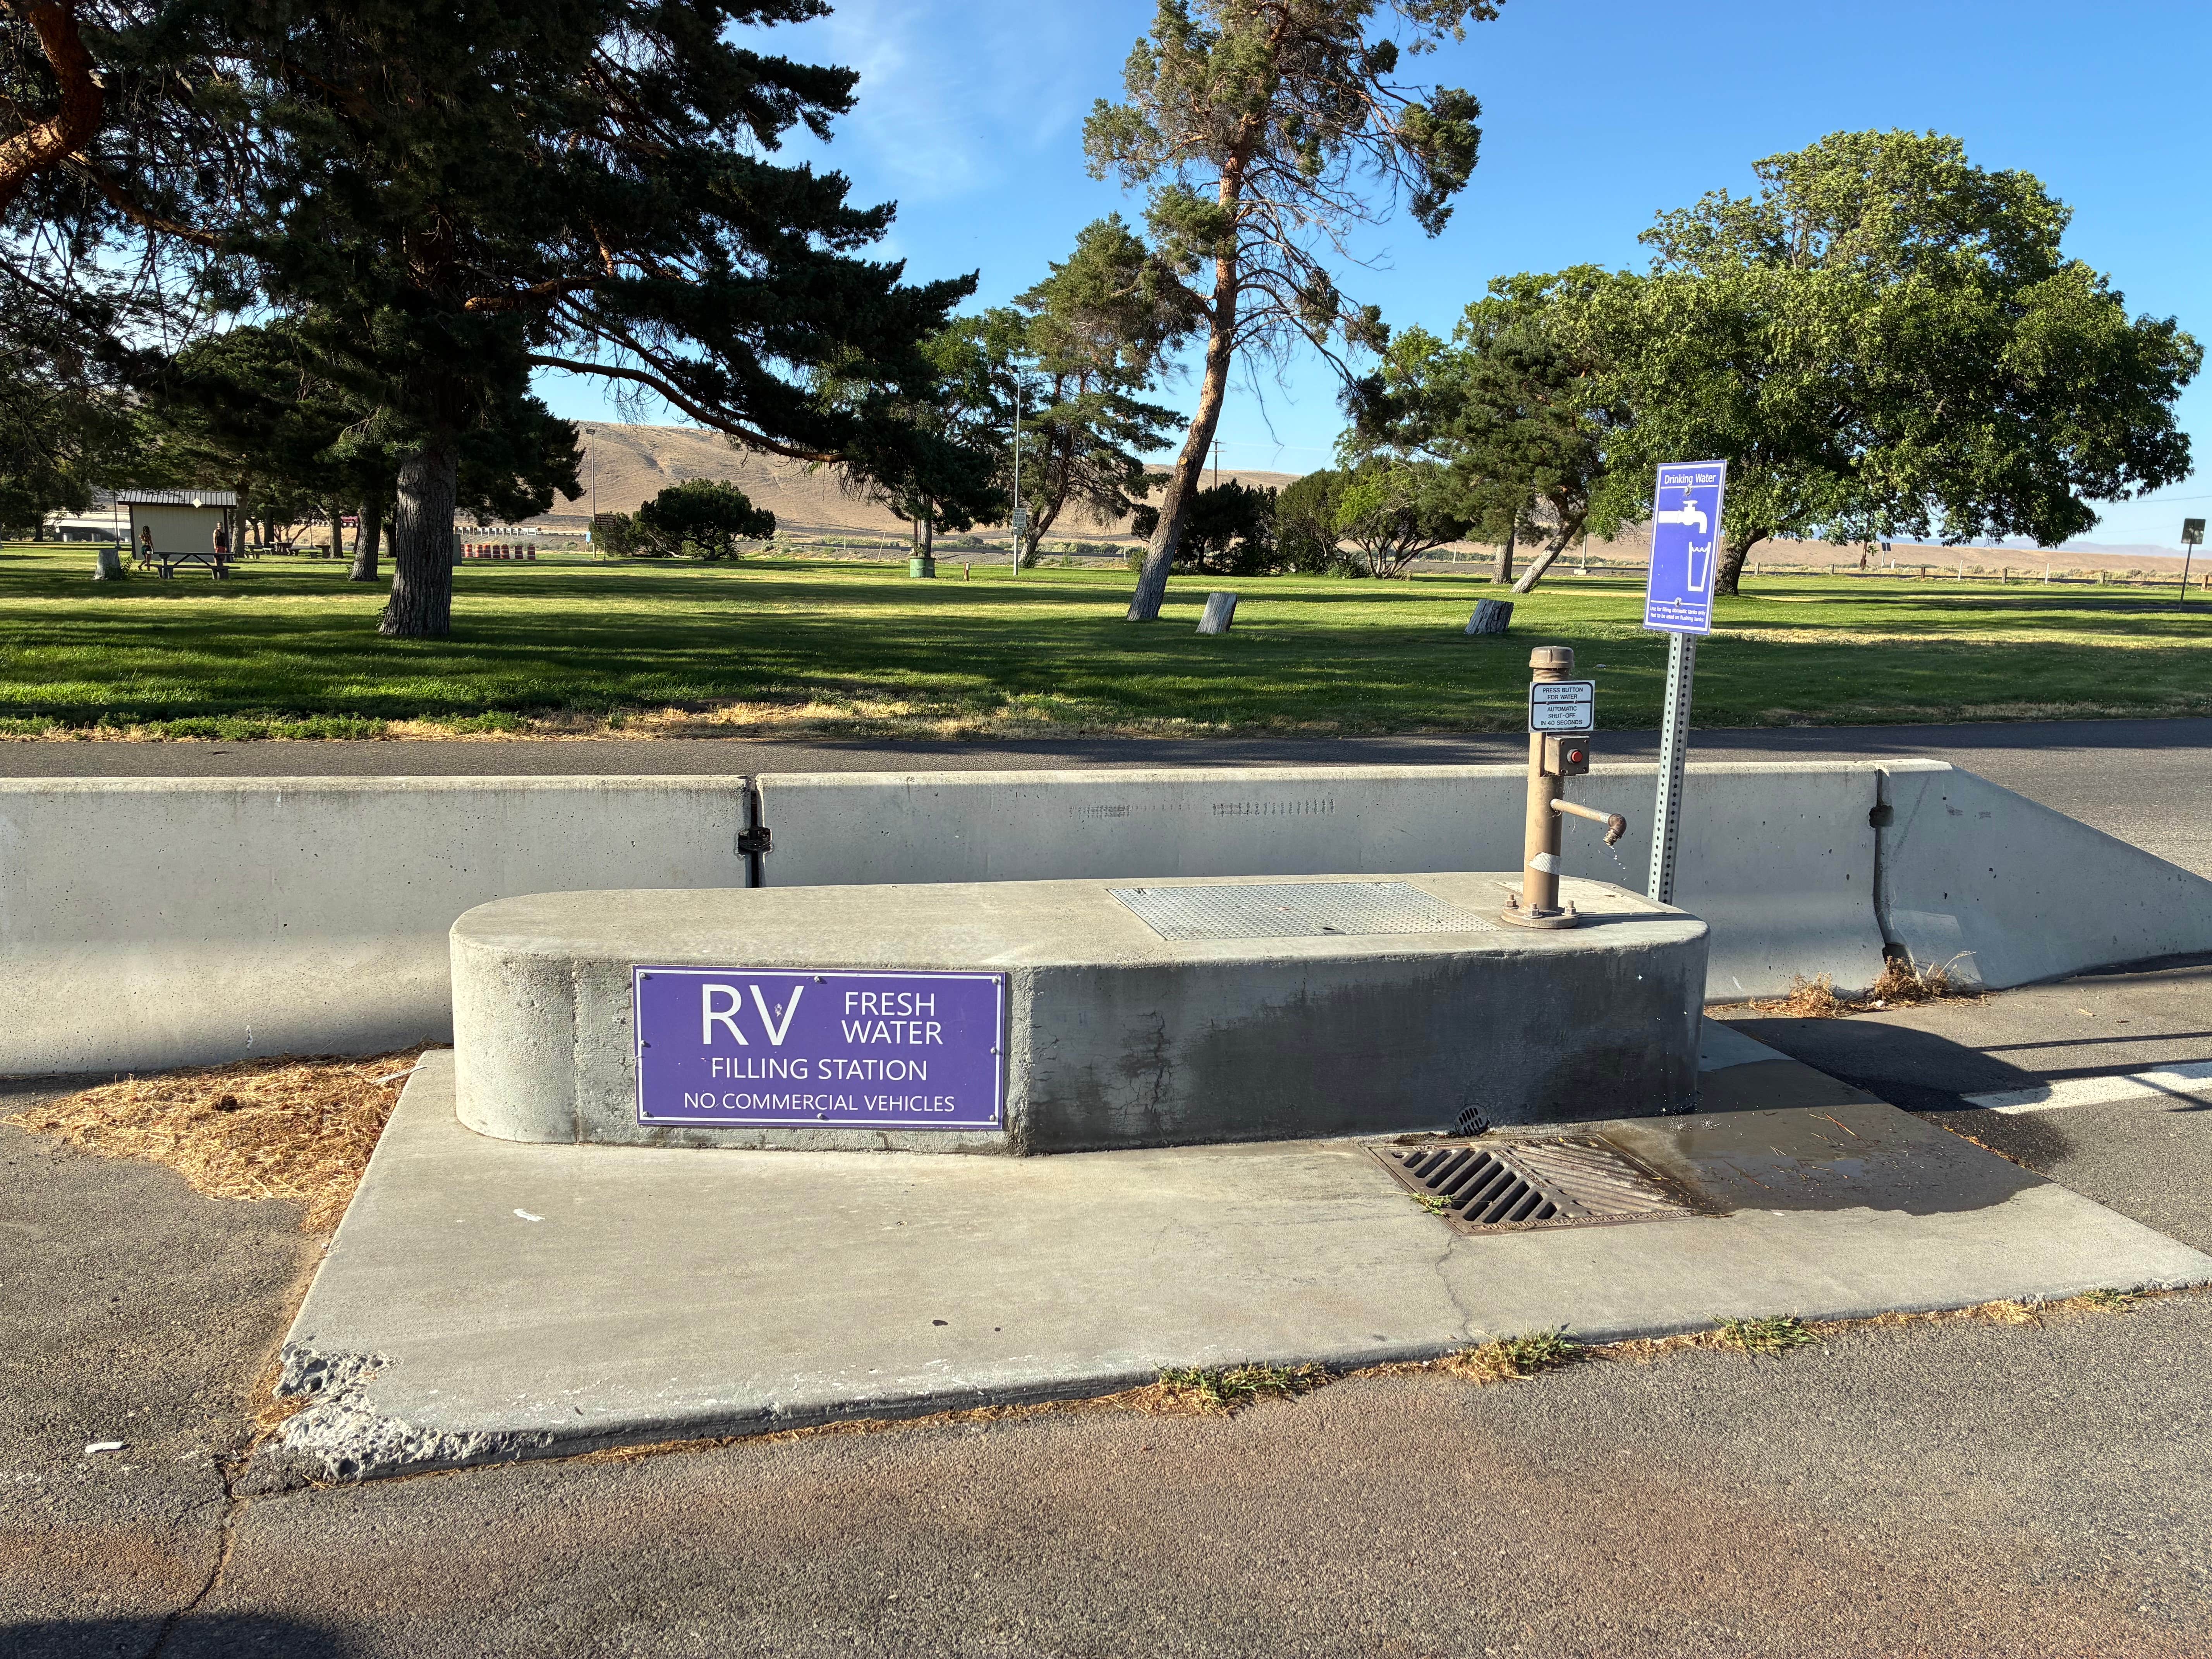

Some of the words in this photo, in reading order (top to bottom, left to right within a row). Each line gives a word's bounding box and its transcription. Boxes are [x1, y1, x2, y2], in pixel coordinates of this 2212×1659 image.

[1664, 474, 1693, 486] Drinking
[1695, 473, 1716, 483] Water
[702, 984, 804, 1046] RV
[845, 991, 934, 1016] FRESH
[841, 1020, 943, 1045] WATER
[712, 1057, 808, 1079] FILLING
[818, 1059, 927, 1081] STATION
[684, 1092, 715, 1109] NO
[723, 1093, 858, 1111] COMMERCIAL
[864, 1095, 955, 1112] VEHICLES
